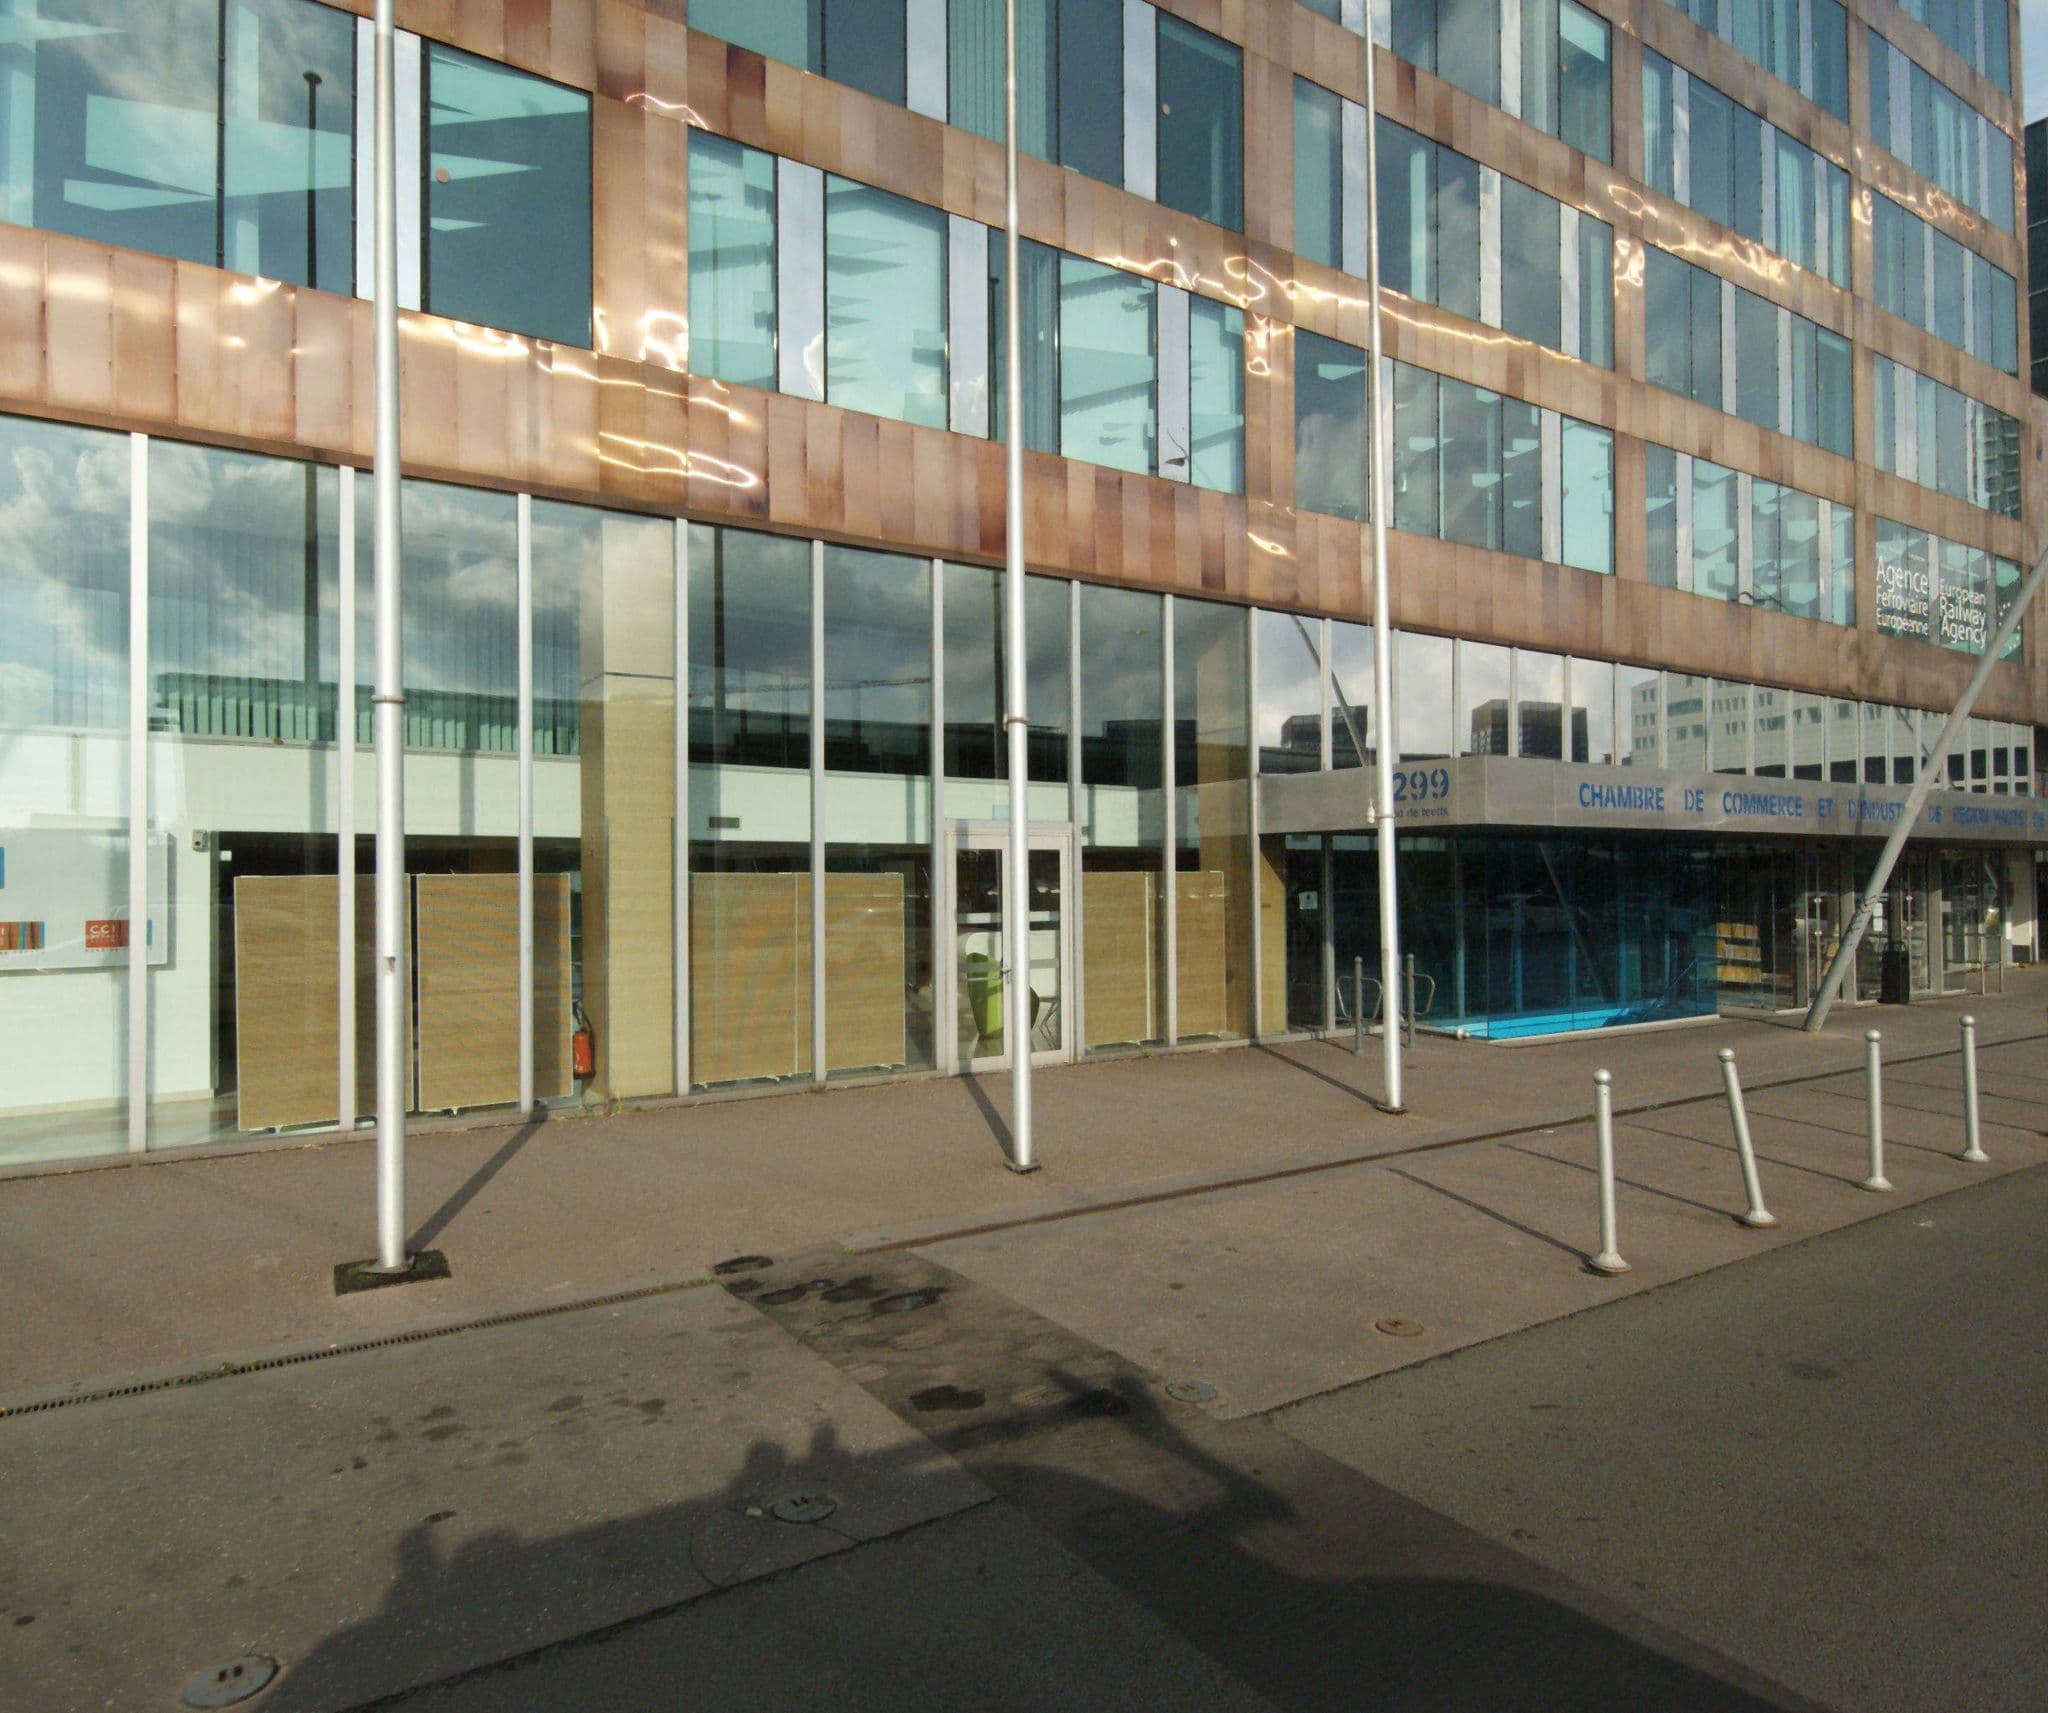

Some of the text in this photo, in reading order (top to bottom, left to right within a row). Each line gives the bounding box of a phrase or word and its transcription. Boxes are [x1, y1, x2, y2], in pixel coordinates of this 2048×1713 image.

[1876, 556, 1929, 594] Agence
[1876, 585, 1929, 616] Ferroviaire
[1939, 579, 1986, 606] European
[1939, 597, 1986, 631] Railway
[1940, 618, 1987, 649] Agency
[1393, 768, 1449, 801] 299
[1578, 783, 1665, 811] CHAMBRE
[1683, 788, 1704, 812] DE
[1722, 791, 1803, 817] COMMERCE
[1817, 798, 1834, 818] ET
[1928, 805, 1943, 824] DE
[90, 924, 116, 934] CCI
